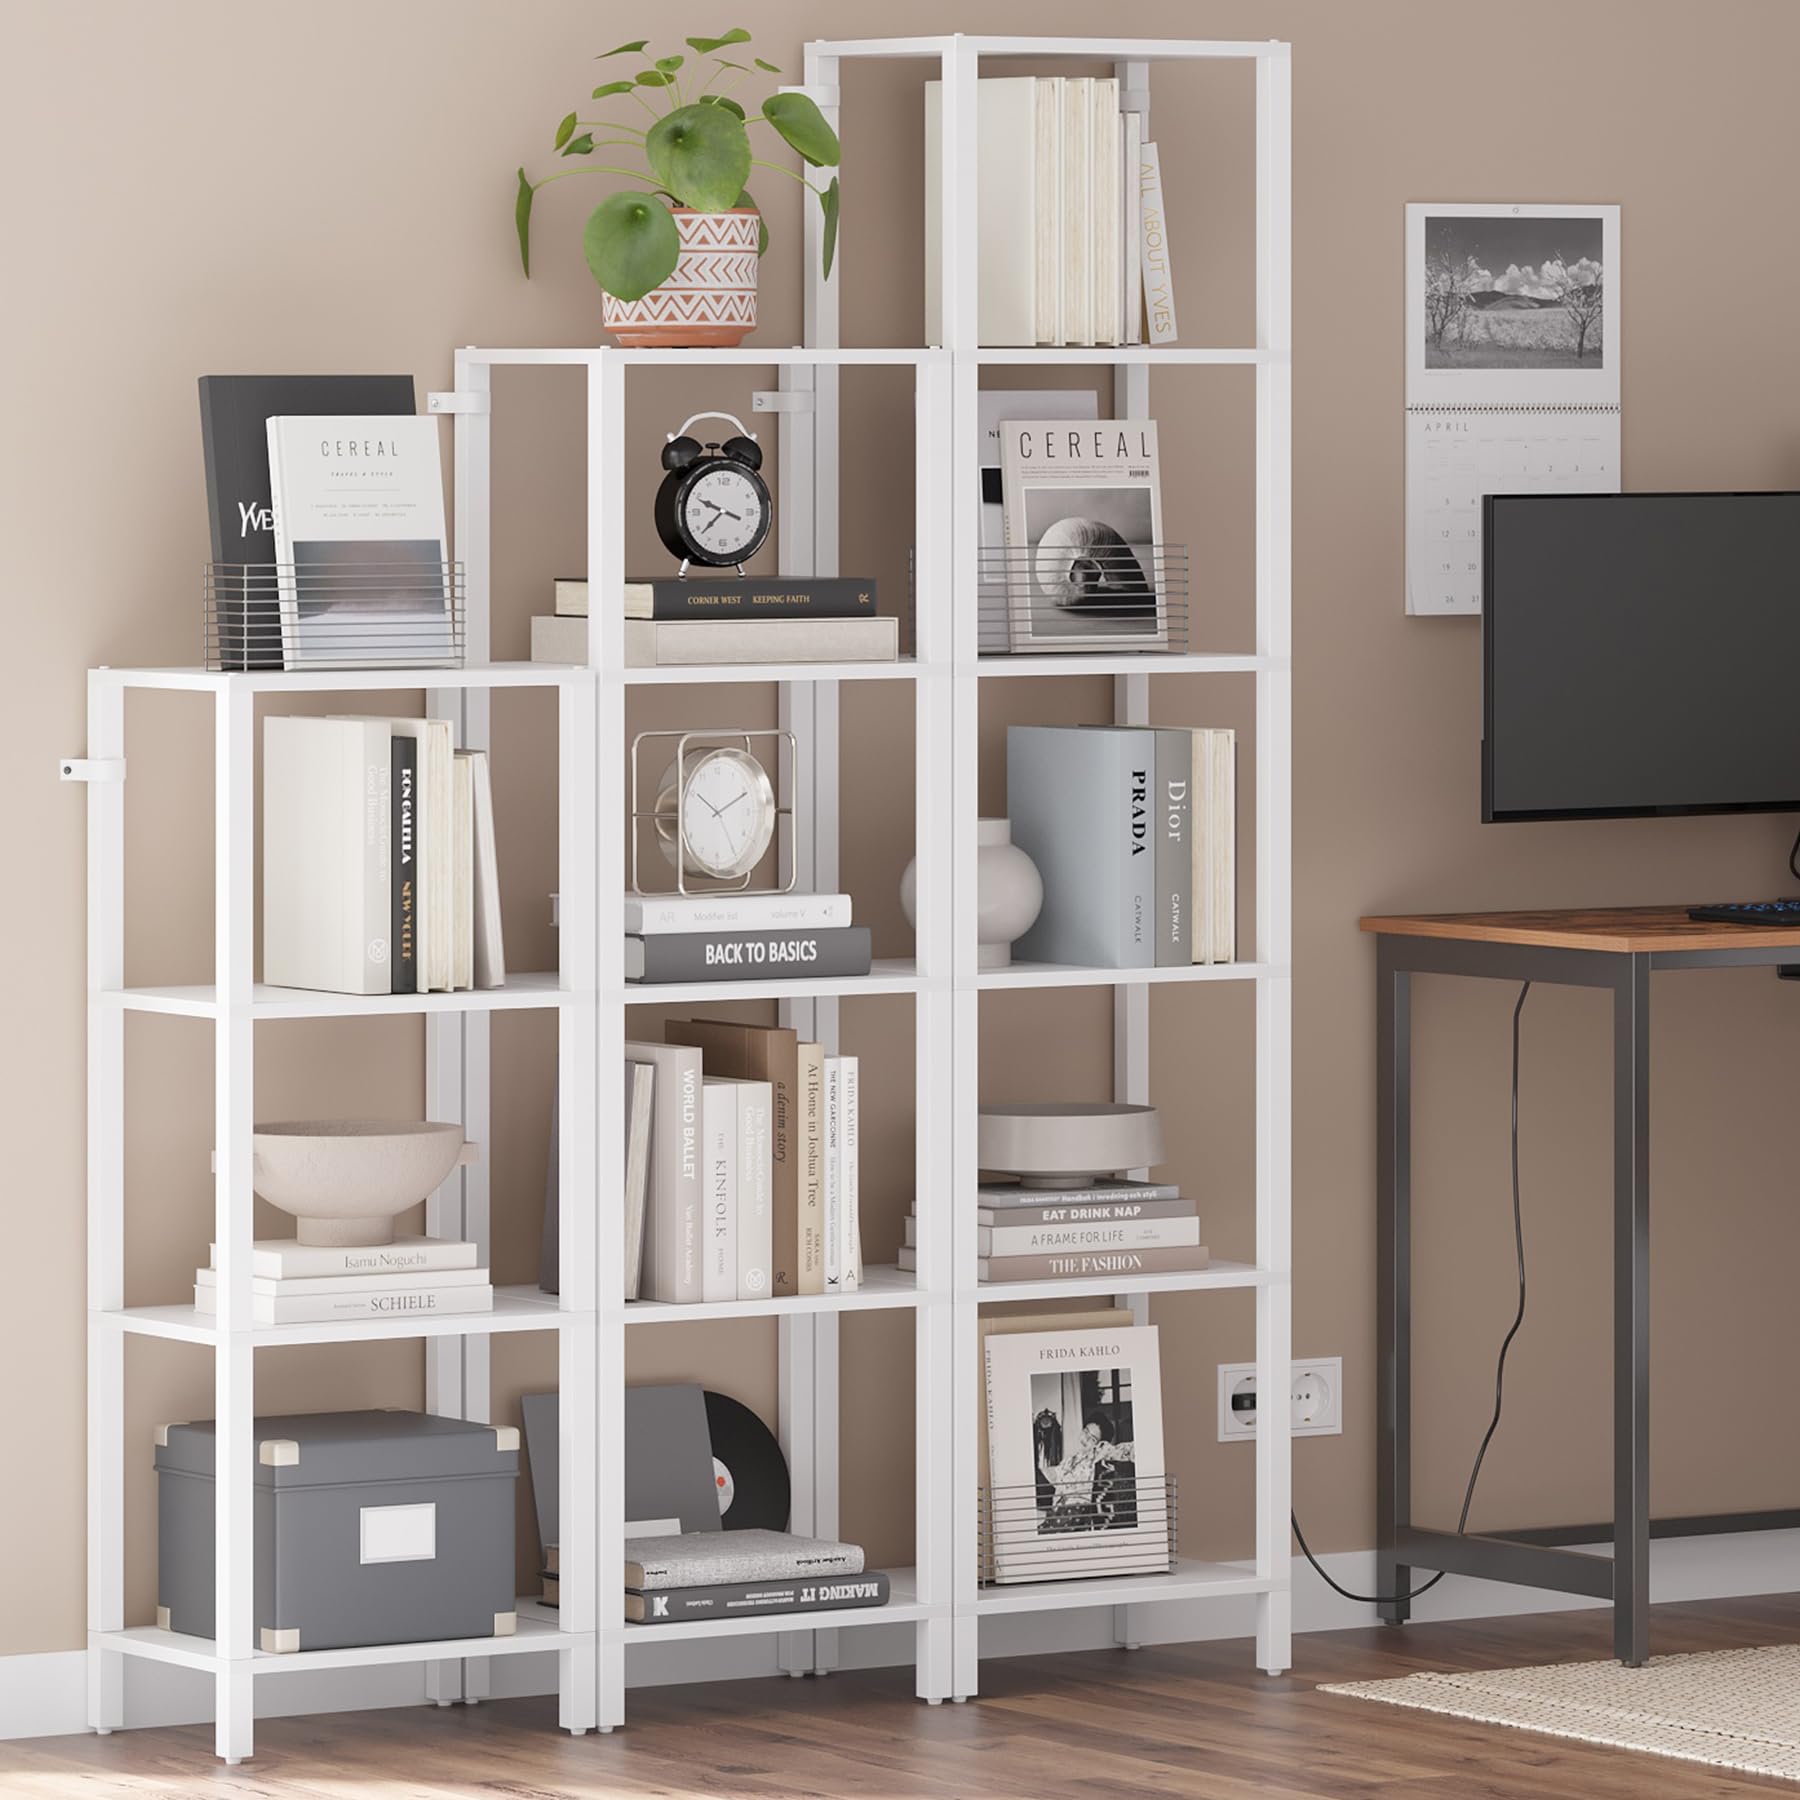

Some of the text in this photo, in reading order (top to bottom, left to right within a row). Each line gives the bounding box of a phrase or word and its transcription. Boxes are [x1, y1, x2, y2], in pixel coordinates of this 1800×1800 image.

[1143, 207, 1166, 275] ABOUT
[1151, 282, 1172, 335] YVES
[1424, 422, 1469, 432] APRIL
[320, 440, 399, 457] CEREAL
[1019, 431, 1152, 459] CEREAL
[237, 502, 275, 538] YVE
[687, 594, 810, 605] CORNER WEST KEEPING FAITH
[1131, 770, 1146, 856] PRADA
[1168, 780, 1186, 842] Dior
[1134, 895, 1142, 944] CATWALK
[1172, 893, 1180, 943] CATWALK
[705, 939, 817, 965] BACK TO BASICS
[682, 1068, 695, 1123] WORLD
[773, 1082, 789, 1163] a denim story
[807, 1063, 819, 1208] At Home in Joshua Tree
[682, 1128, 695, 1180] BALLET
[715, 1159, 726, 1238] KINFOLK
[1042, 1206, 1142, 1221] EAT DRINK NAP
[1031, 1235, 1039, 1246] A
[1040, 1233, 1078, 1245] FRAME
[1080, 1231, 1100, 1244] FOR
[1102, 1230, 1124, 1242] LIFE
[344, 1252, 427, 1269] Isamu Noguchi
[1048, 1255, 1143, 1273] THE FASHION
[370, 1294, 436, 1312] SCHIELE
[1039, 1344, 1121, 1360] FRIDA KAHLO
[800, 1587, 816, 1602] IT
[819, 1582, 879, 1601] MAKING
[652, 1596, 669, 1617] K
